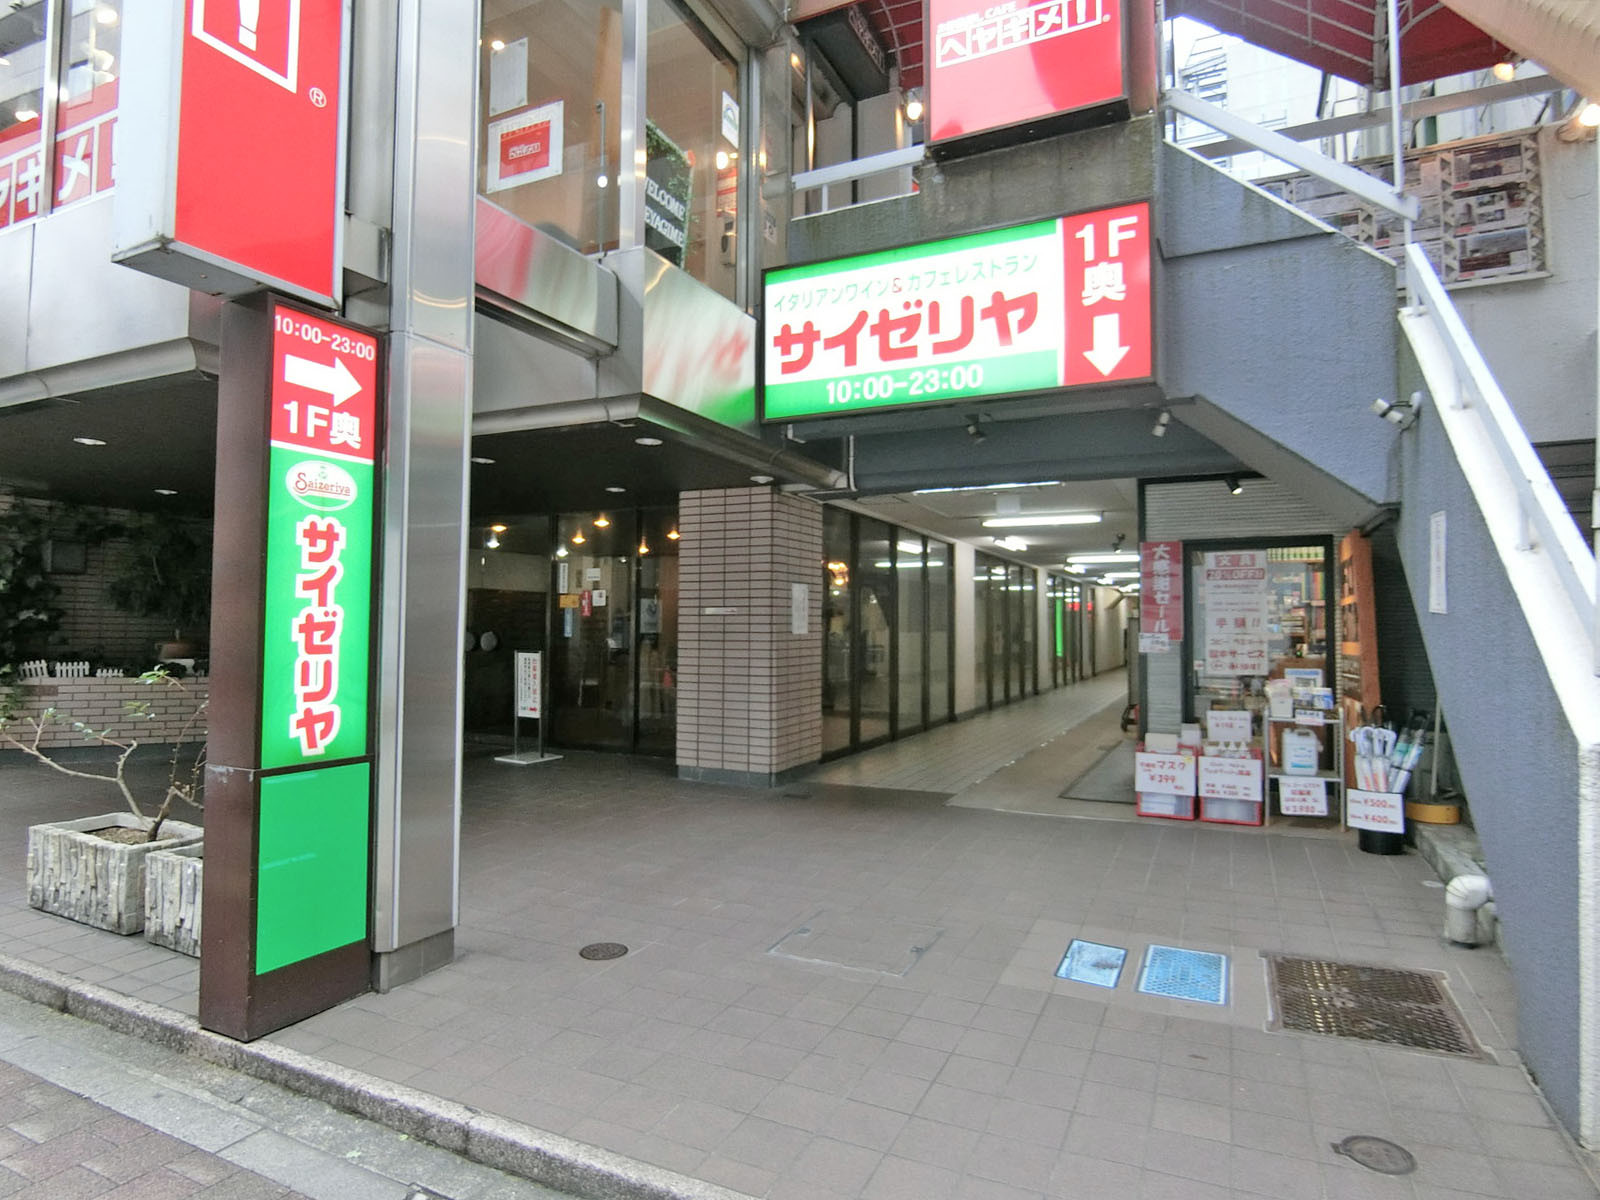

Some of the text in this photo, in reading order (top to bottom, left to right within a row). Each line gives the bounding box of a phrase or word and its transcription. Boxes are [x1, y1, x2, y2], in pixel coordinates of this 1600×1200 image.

[645, 175, 686, 221] ELCOME
[1075, 215, 1139, 262] 1F
[1081, 261, 1127, 306] 奥
[274, 314, 375, 361] 10:00-23:00
[773, 291, 1039, 375] サイゼリヤ
[826, 363, 984, 404] 10:00-23:00
[293, 472, 351, 496] Saizeriya
[295, 519, 341, 751] サイゼリヤ
